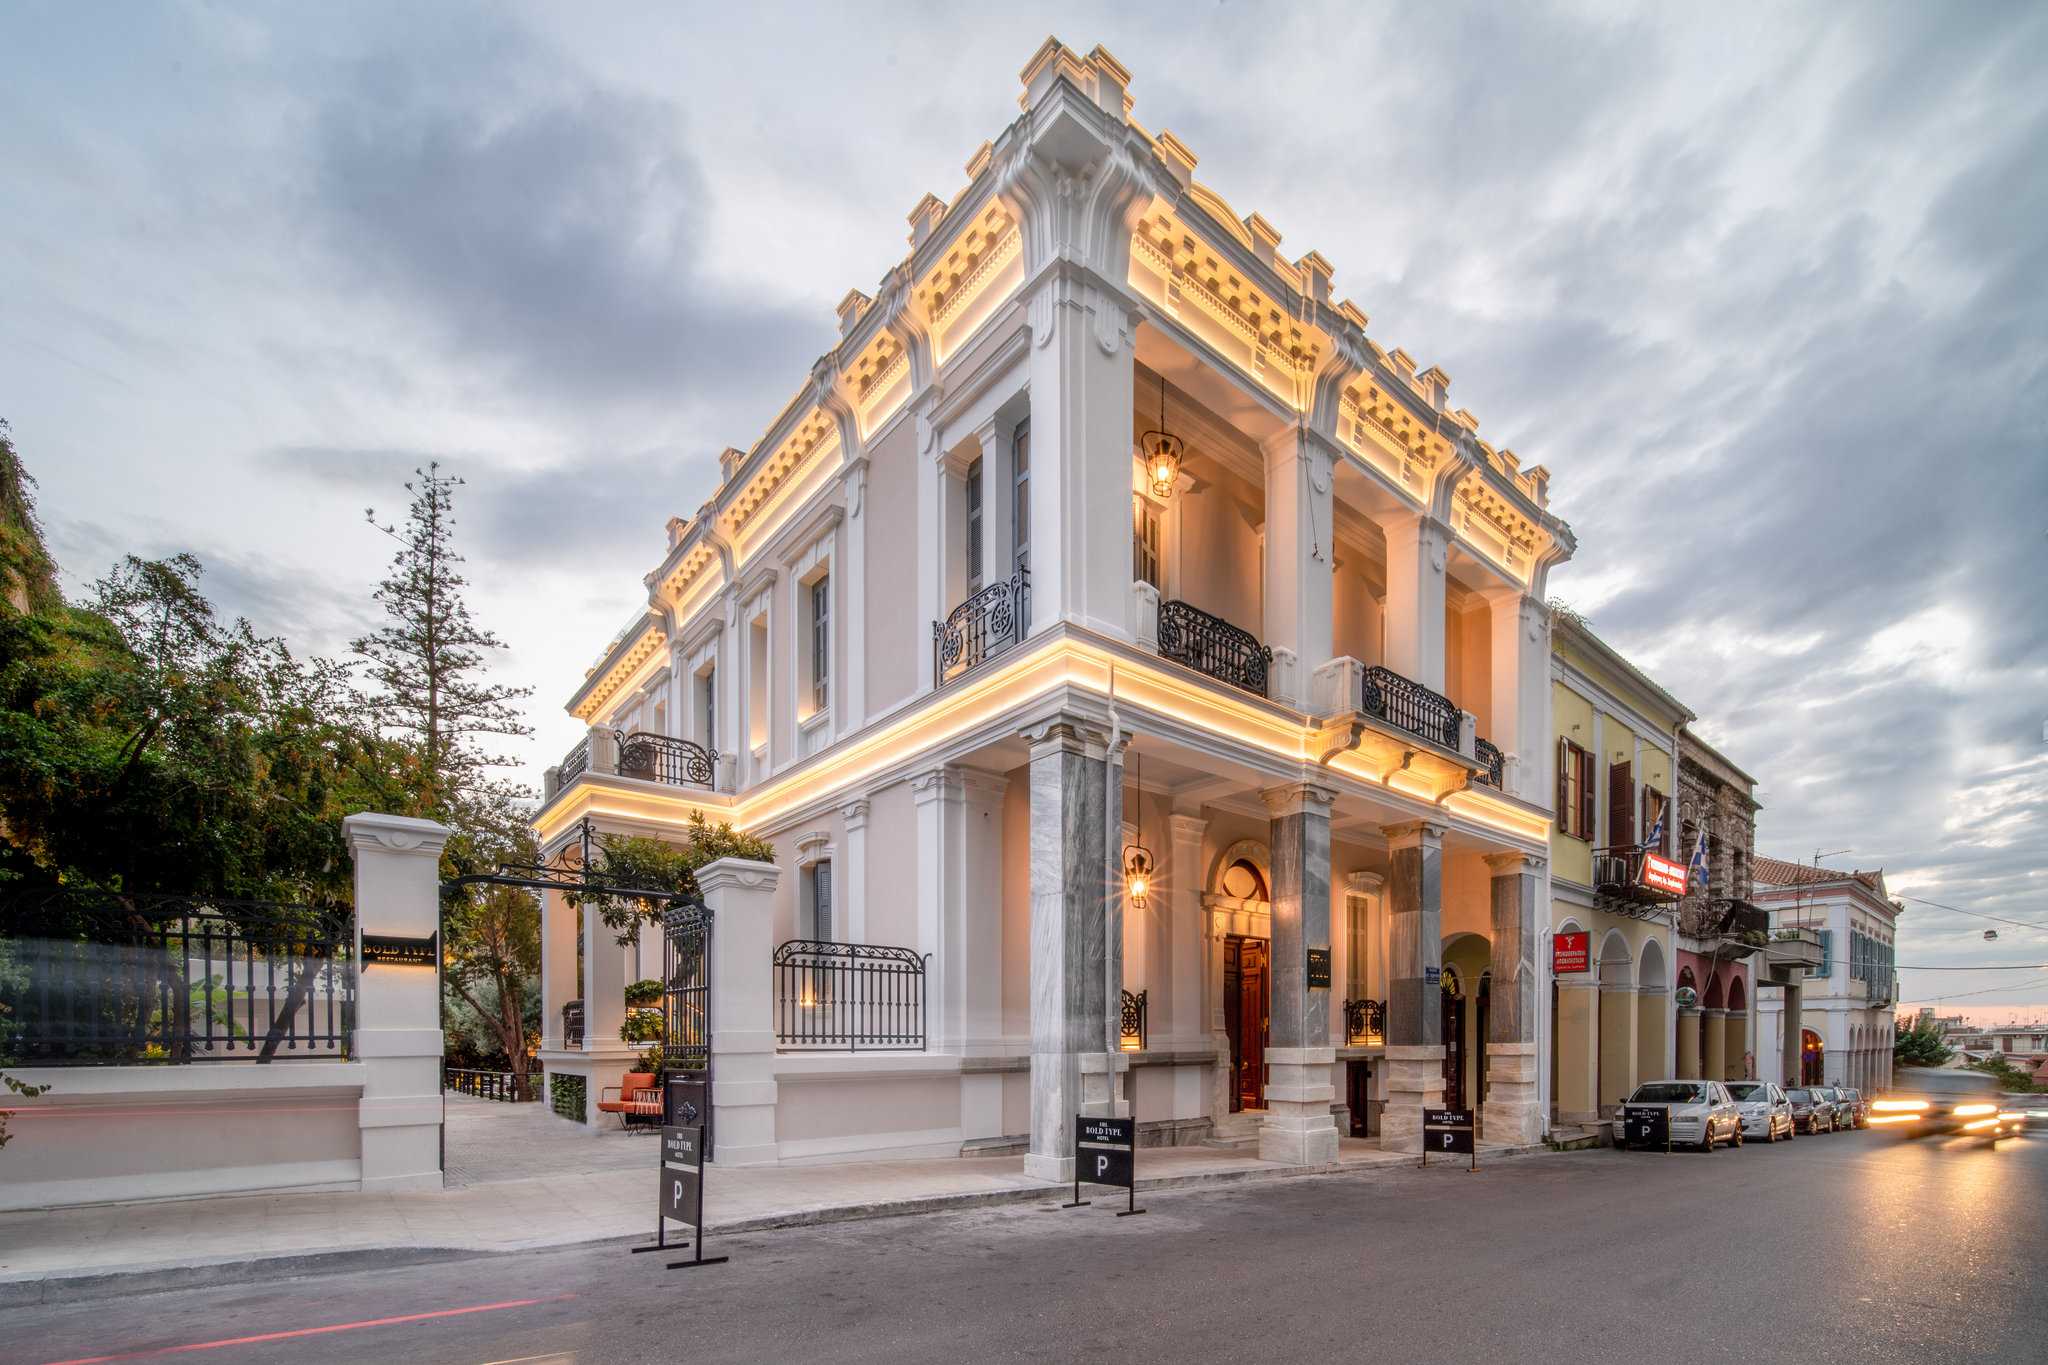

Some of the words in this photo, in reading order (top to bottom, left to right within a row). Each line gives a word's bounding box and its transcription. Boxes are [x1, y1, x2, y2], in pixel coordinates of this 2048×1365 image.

[363, 944, 400, 955] BOLD
[403, 945, 435, 957] TYPE
[377, 956, 423, 964] RESTAURANT
[1085, 1126, 1104, 1136] BOLD
[1105, 1127, 1122, 1137] TYPE
[1642, 1125, 1651, 1137] P
[667, 1139, 680, 1150] BOLD
[680, 1140, 693, 1152] TYPE
[1443, 1133, 1454, 1148] P
[1097, 1155, 1108, 1177] P
[673, 1179, 683, 1209] P
